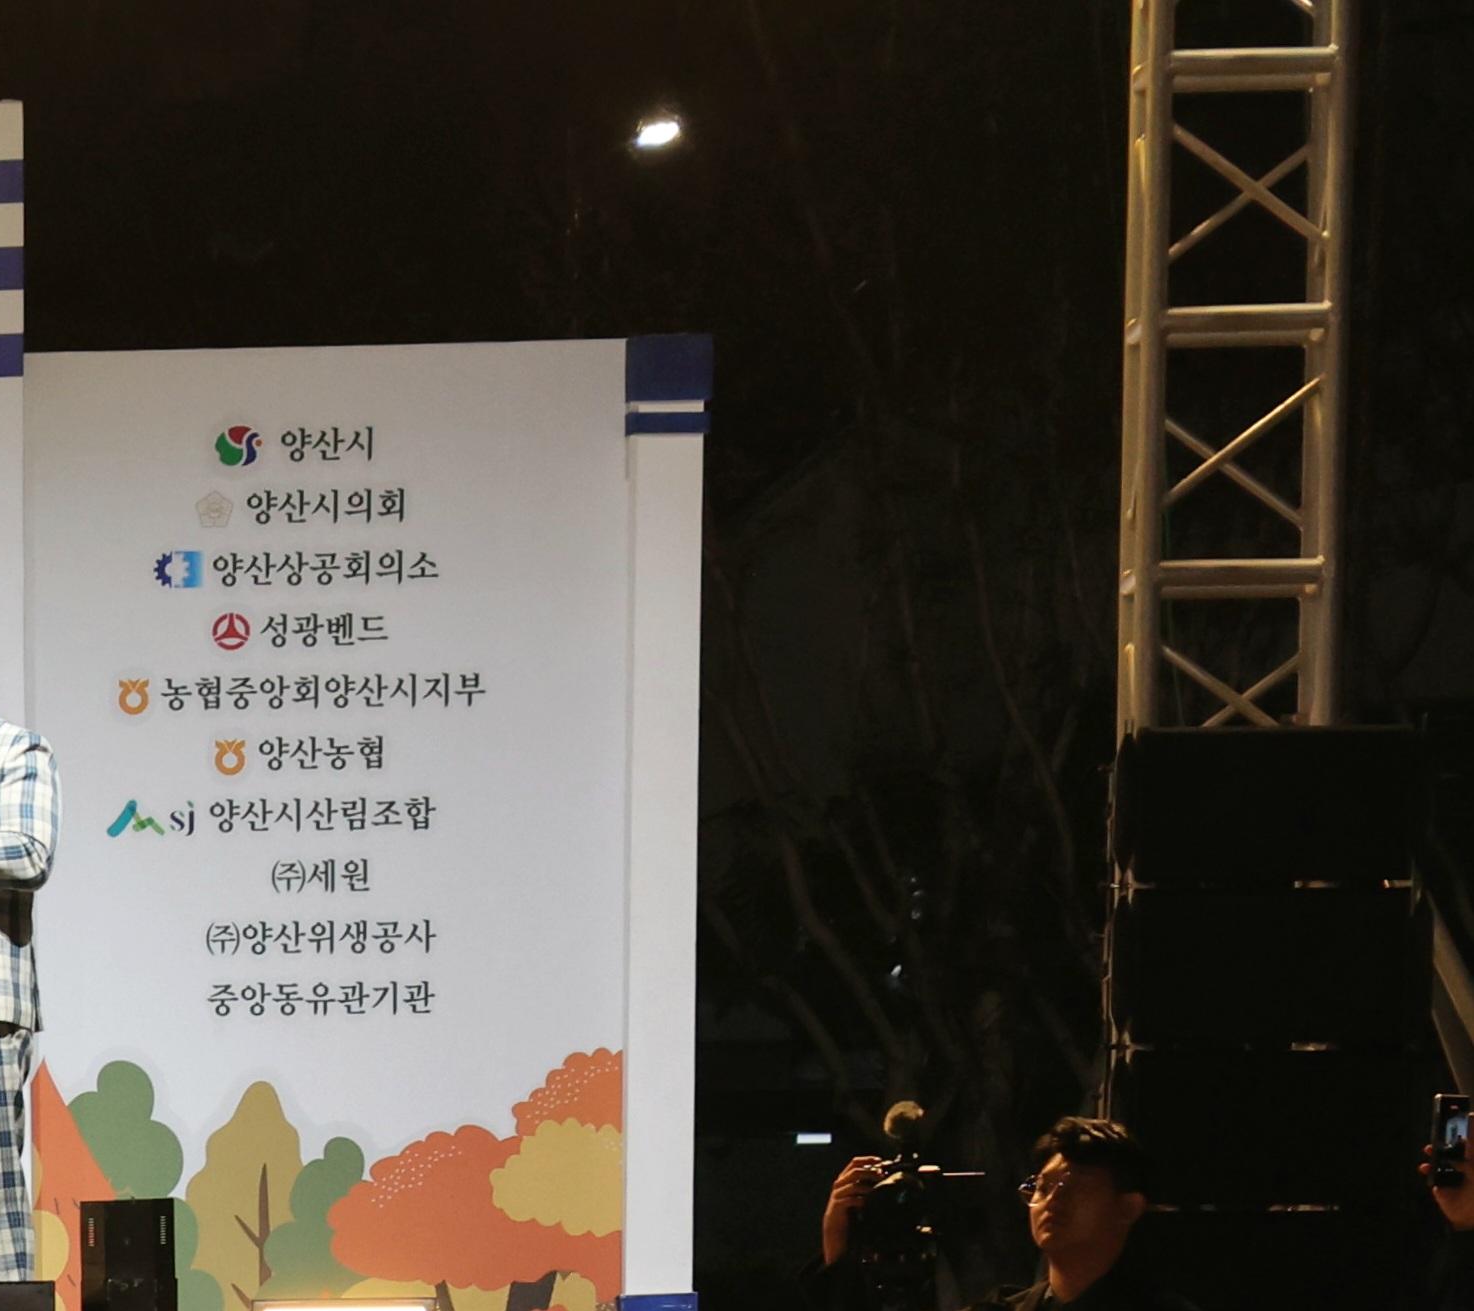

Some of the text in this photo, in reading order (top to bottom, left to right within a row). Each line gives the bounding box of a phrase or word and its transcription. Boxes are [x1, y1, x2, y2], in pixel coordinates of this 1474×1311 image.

[280, 425, 374, 463] 양산시
[246, 487, 405, 525] 양산시의회
[212, 549, 440, 588] 양산상공회의소
[259, 612, 389, 649] 성광벤드
[160, 671, 487, 712] 농협중앙회양산시지부
[258, 735, 384, 772] 양산농협
[209, 795, 437, 834] 양산시산림조합
[207, 980, 436, 1017] 중앙동유관기관
